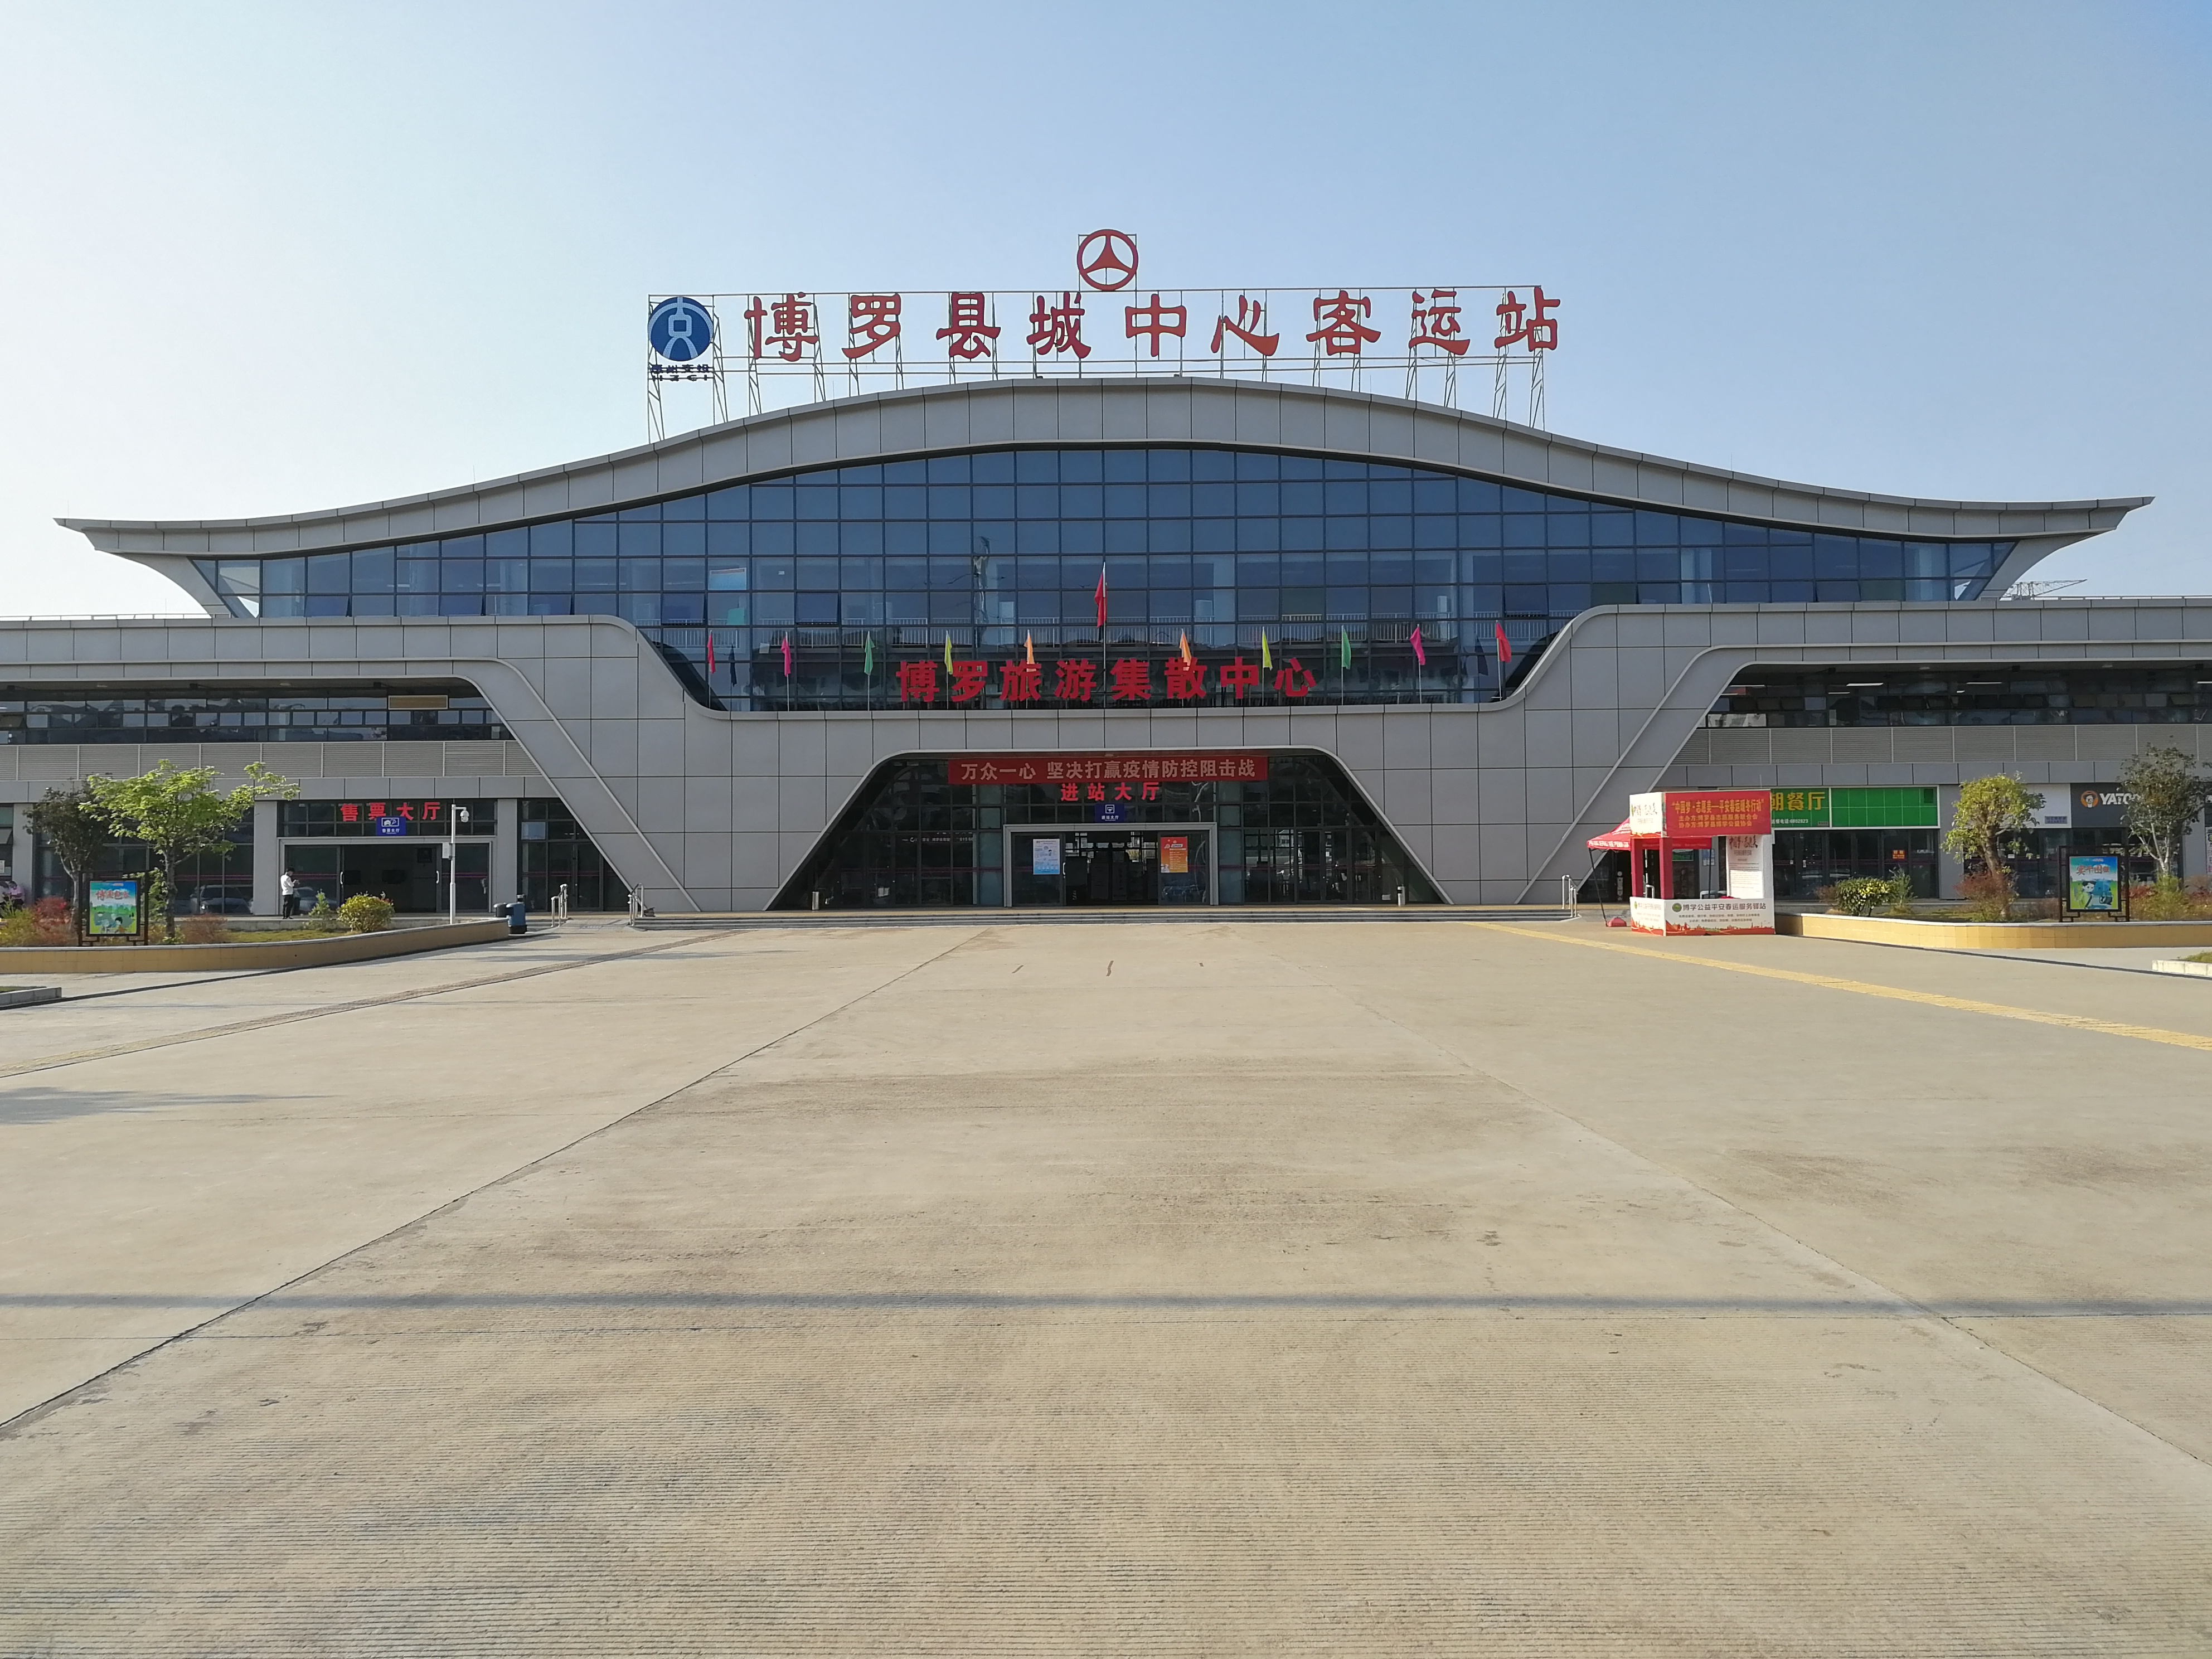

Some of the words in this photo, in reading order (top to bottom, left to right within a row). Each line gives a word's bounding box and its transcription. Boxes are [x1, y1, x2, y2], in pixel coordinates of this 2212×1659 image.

[744, 287, 1560, 362] 博罗县城中心客运站
[895, 657, 1316, 702] 博罗旅游集散中心
[961, 762, 1036, 780] 万众一心
[1047, 759, 1255, 779] 坚决打赢疫情防控阻击战
[1061, 782, 1160, 801] 进站大厅
[340, 802, 440, 822] 售票大厅
[1682, 903, 1766, 911] 博学公益平安春运服务驿站
